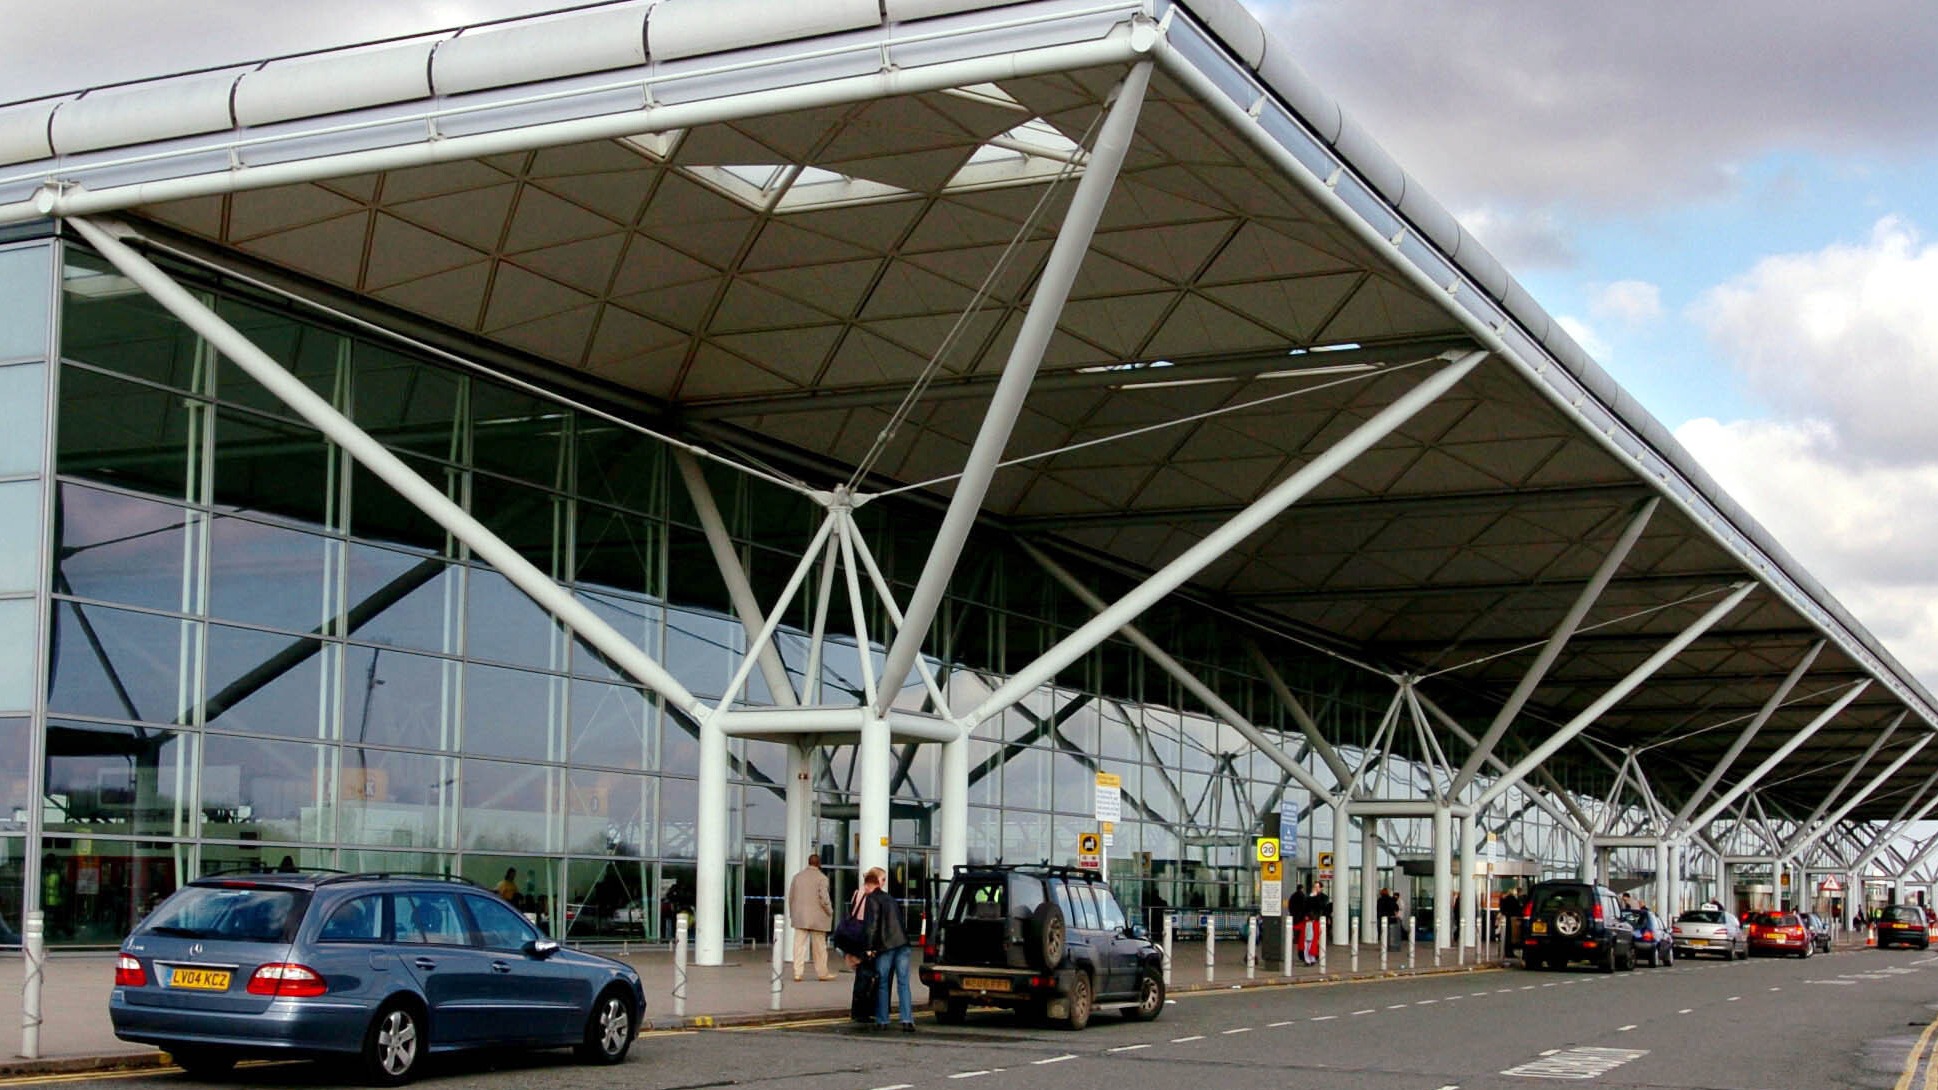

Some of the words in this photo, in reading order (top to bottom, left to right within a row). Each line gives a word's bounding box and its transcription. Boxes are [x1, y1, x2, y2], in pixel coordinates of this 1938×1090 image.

[1262, 846, 1274, 854] 20
[173, 970, 201, 984] LV04
[204, 972, 227, 987] KCZ
